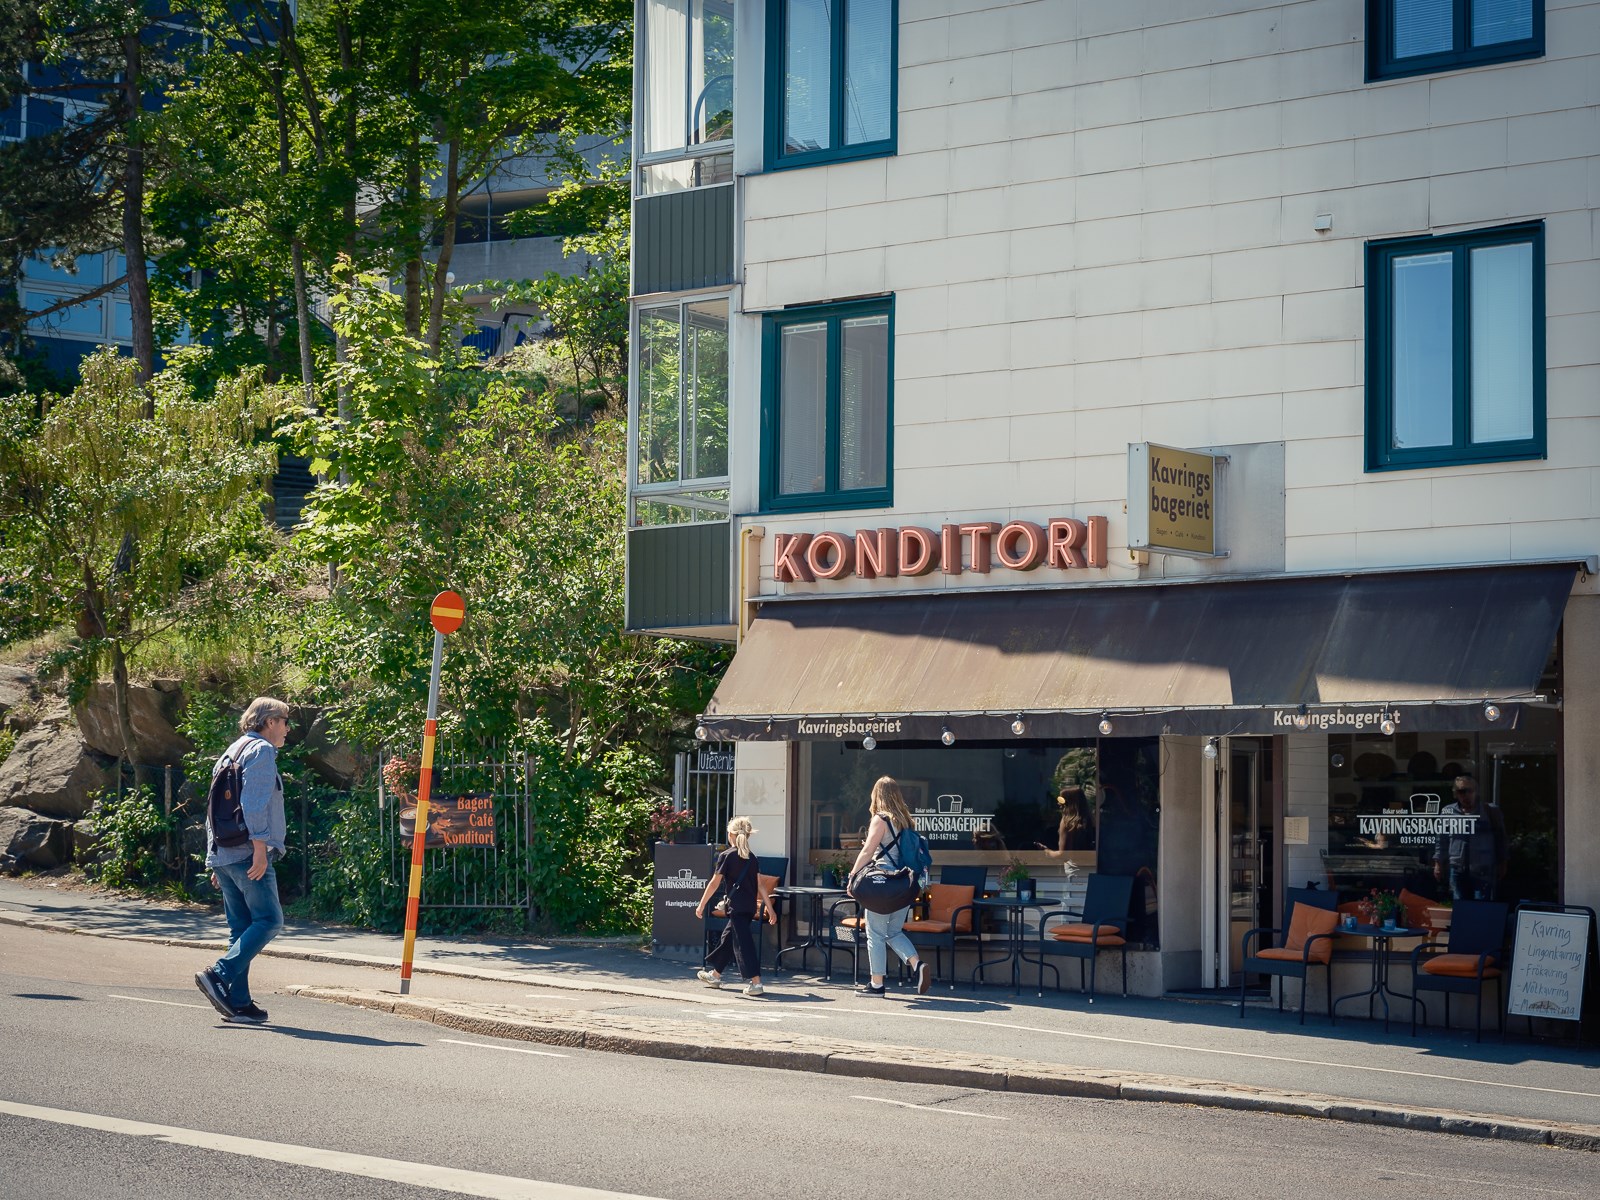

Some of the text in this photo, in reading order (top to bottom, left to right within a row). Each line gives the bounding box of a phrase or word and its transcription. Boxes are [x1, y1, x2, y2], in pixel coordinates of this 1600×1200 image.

[1151, 456, 1211, 497] Kavrings
[1151, 486, 1210, 522] bageriet
[774, 515, 1108, 583] KONDITORI
[797, 718, 902, 738] Kavringsbageriet
[1273, 708, 1401, 730] Kavingsbagerit
[457, 796, 493, 813] Bageri
[469, 811, 494, 827] Café
[914, 816, 993, 832] RINGSBAGERIET
[1359, 818, 1478, 835] KAVRINGSBAGERIET
[443, 830, 494, 845] Konditori
[1400, 836, 1436, 844] 031-167182
[1531, 920, 1571, 948] Kavring
